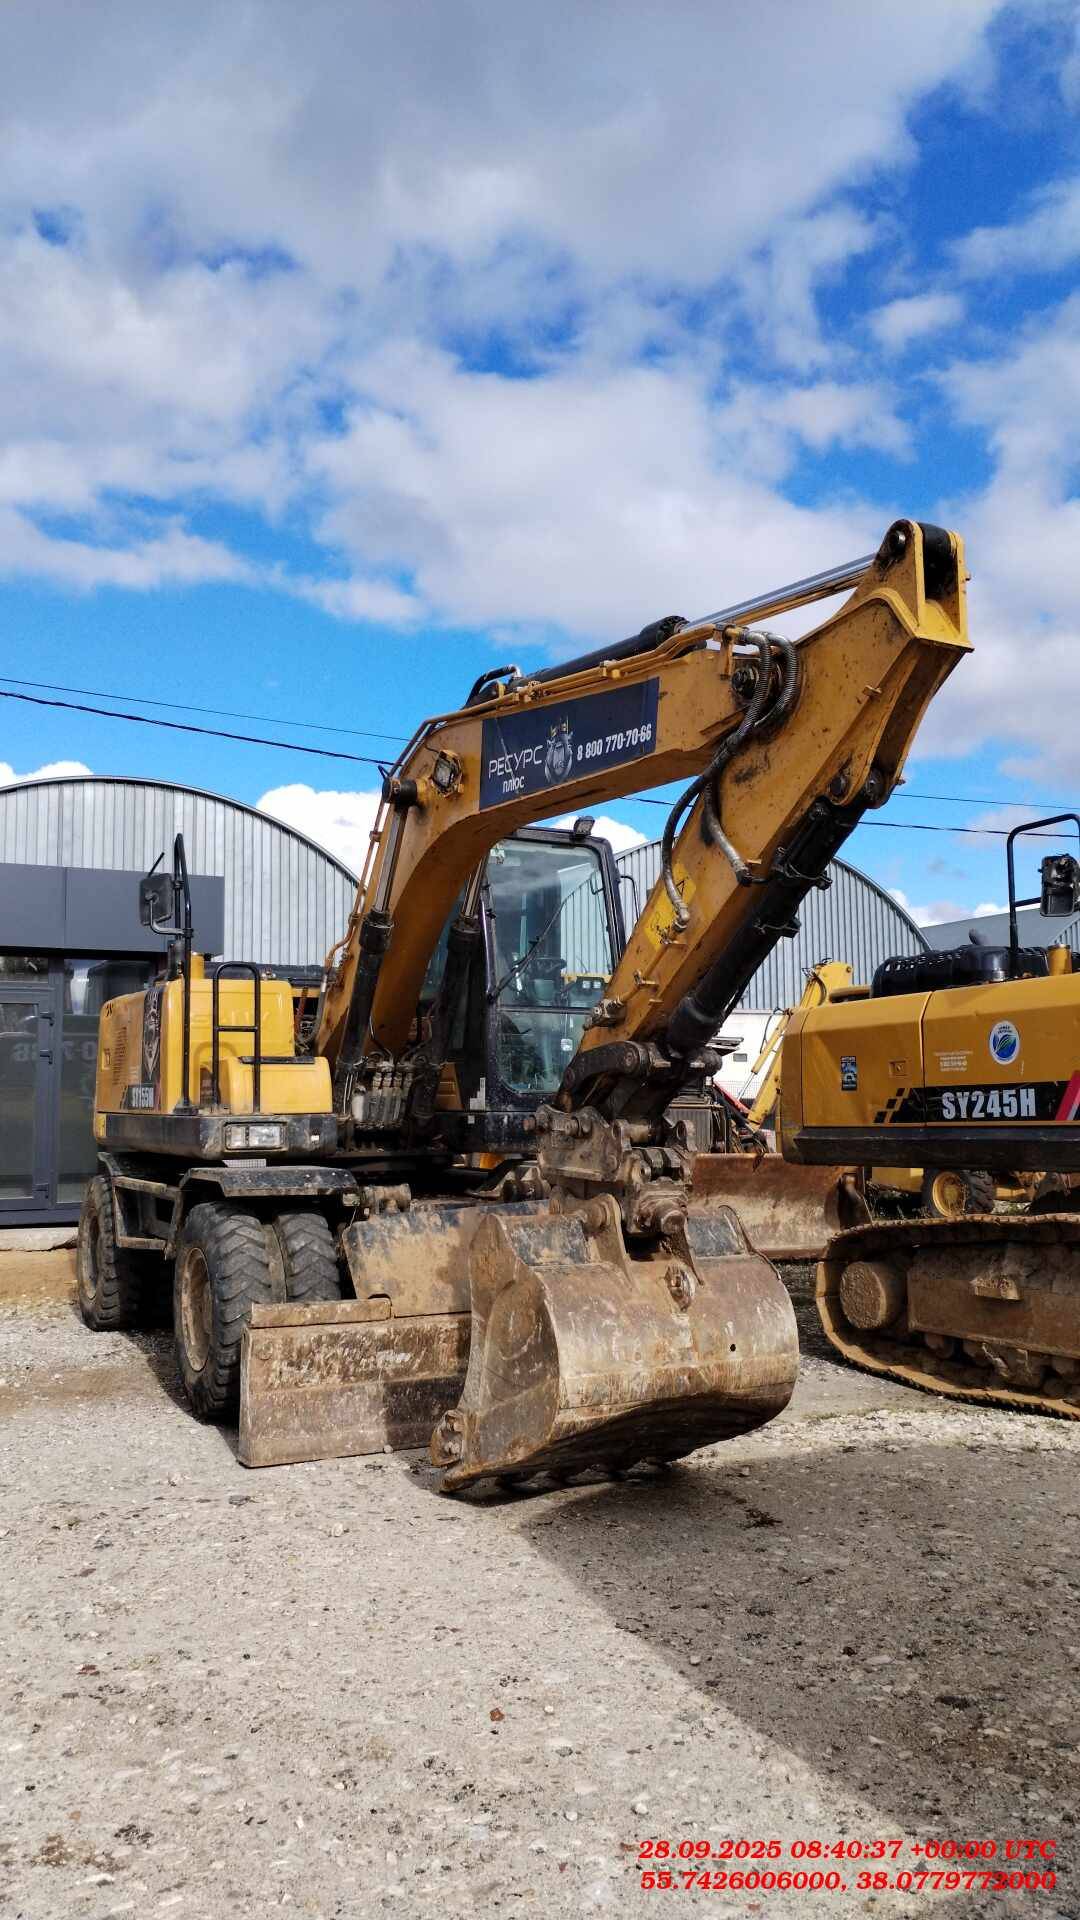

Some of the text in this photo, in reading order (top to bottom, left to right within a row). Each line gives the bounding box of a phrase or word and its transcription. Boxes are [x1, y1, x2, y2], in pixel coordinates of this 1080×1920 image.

[577, 723, 652, 761] 8 800 770-70-66
[488, 745, 544, 779] РЕСУРС
[941, 1088, 1036, 1120] SY245H
